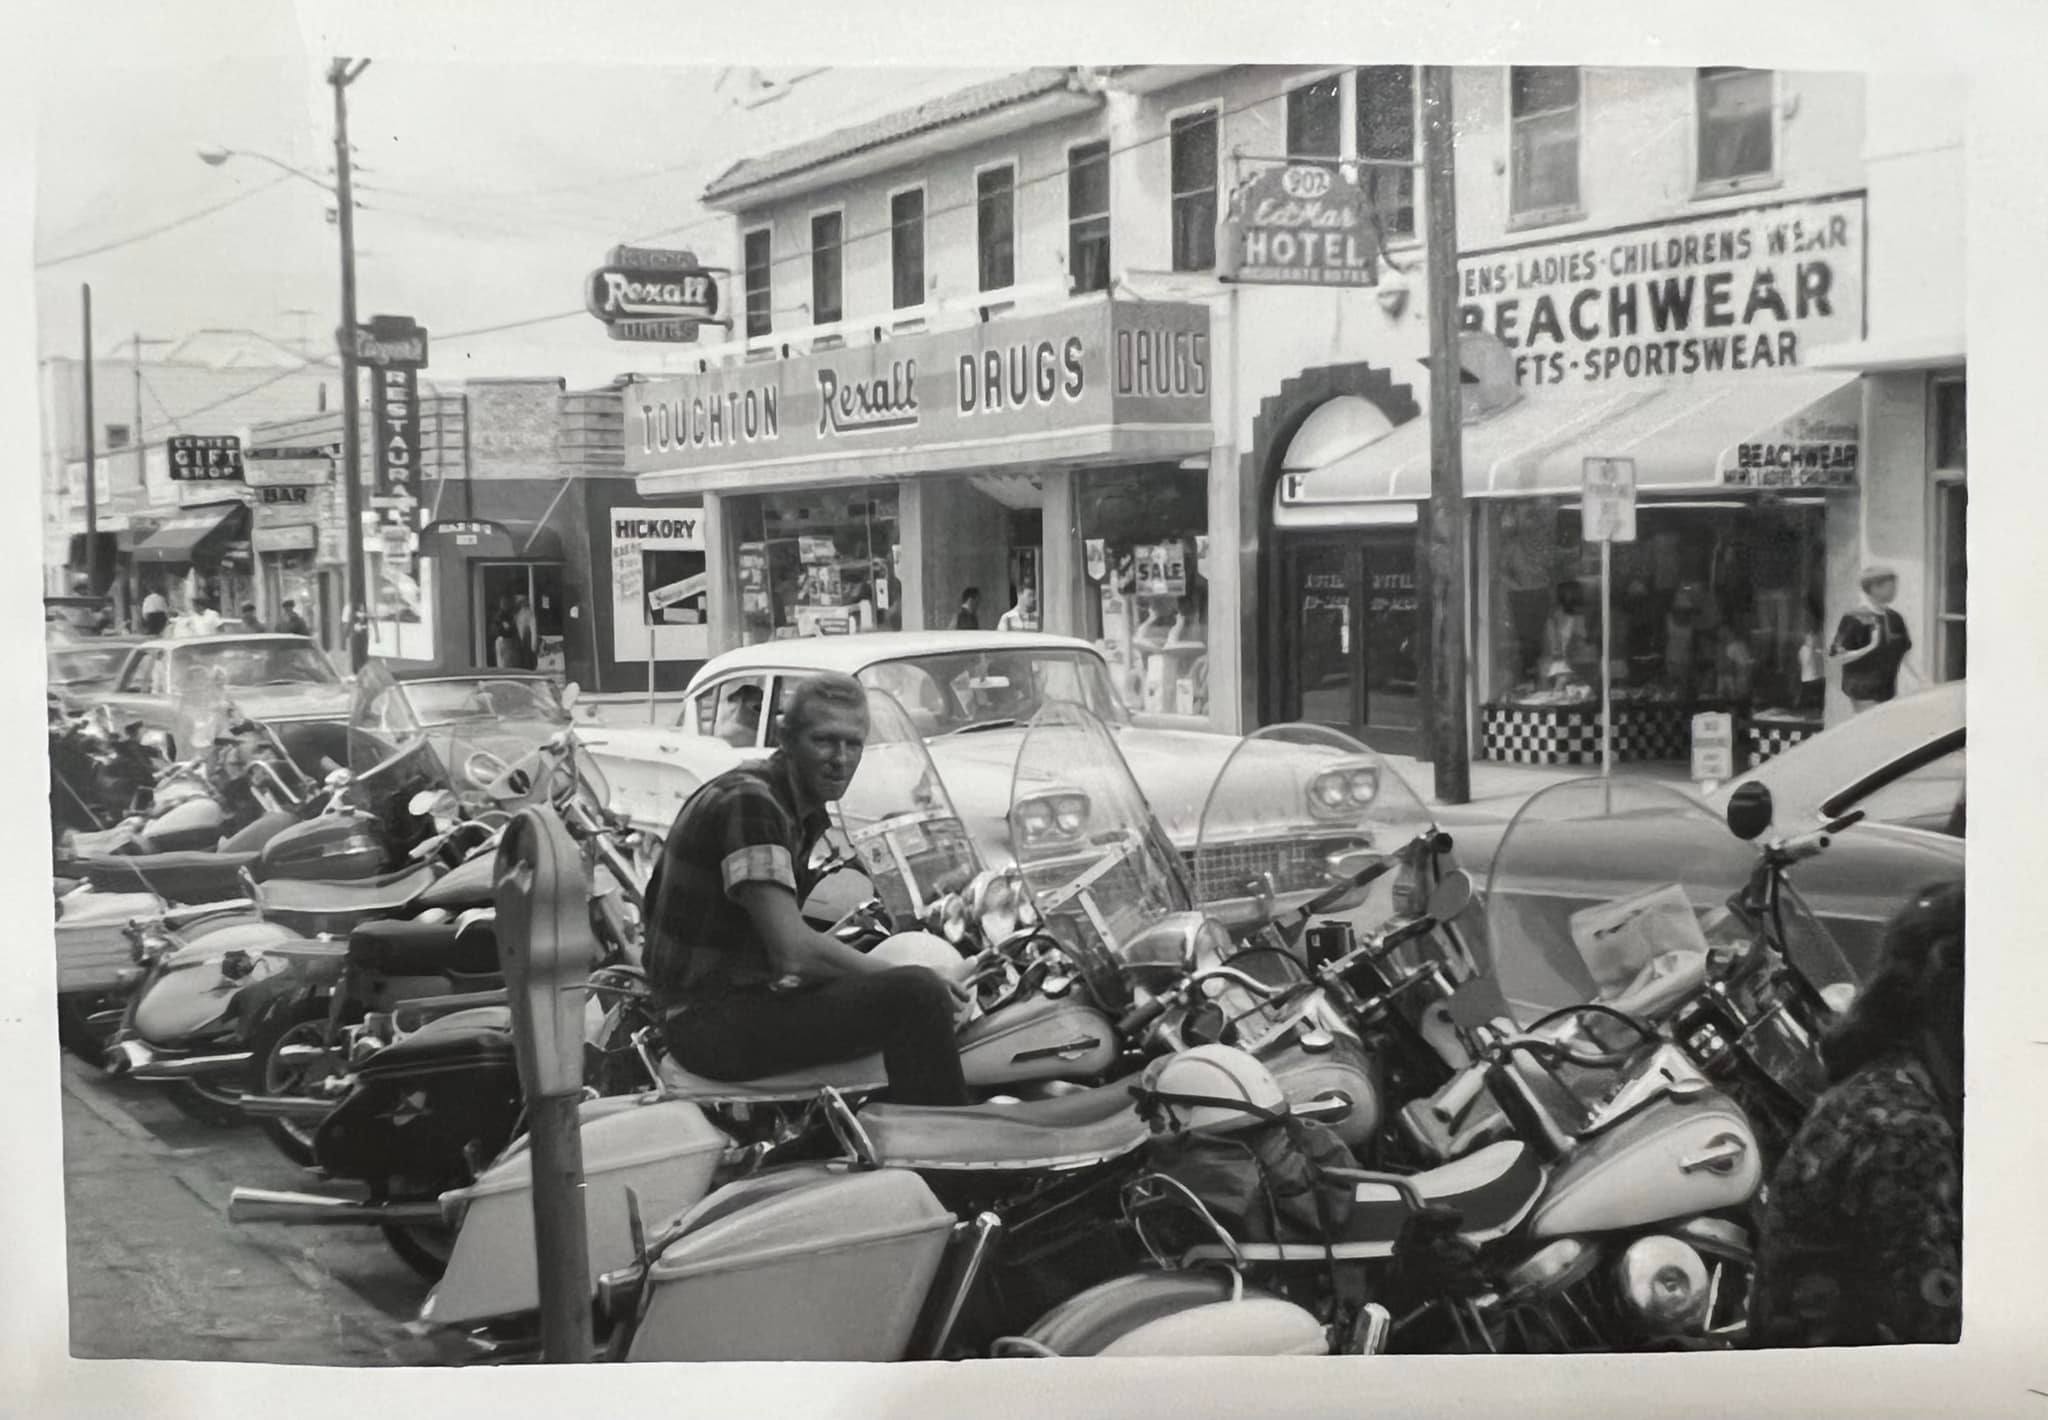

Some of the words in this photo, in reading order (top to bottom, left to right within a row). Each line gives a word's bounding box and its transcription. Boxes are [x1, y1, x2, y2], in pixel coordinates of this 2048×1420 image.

[1246, 230, 1369, 268] HOTEL
[1766, 214, 1848, 257] WEAR
[602, 271, 711, 312] Rexall
[1116, 329, 1208, 397] DRUGS
[640, 384, 780, 454] TOUCHTON
[817, 359, 919, 438] Rexall
[958, 335, 1086, 417] DRUGS
[174, 449, 240, 466] GIFT
[614, 519, 697, 540] HICKORY
[1138, 562, 1184, 581] SALE
